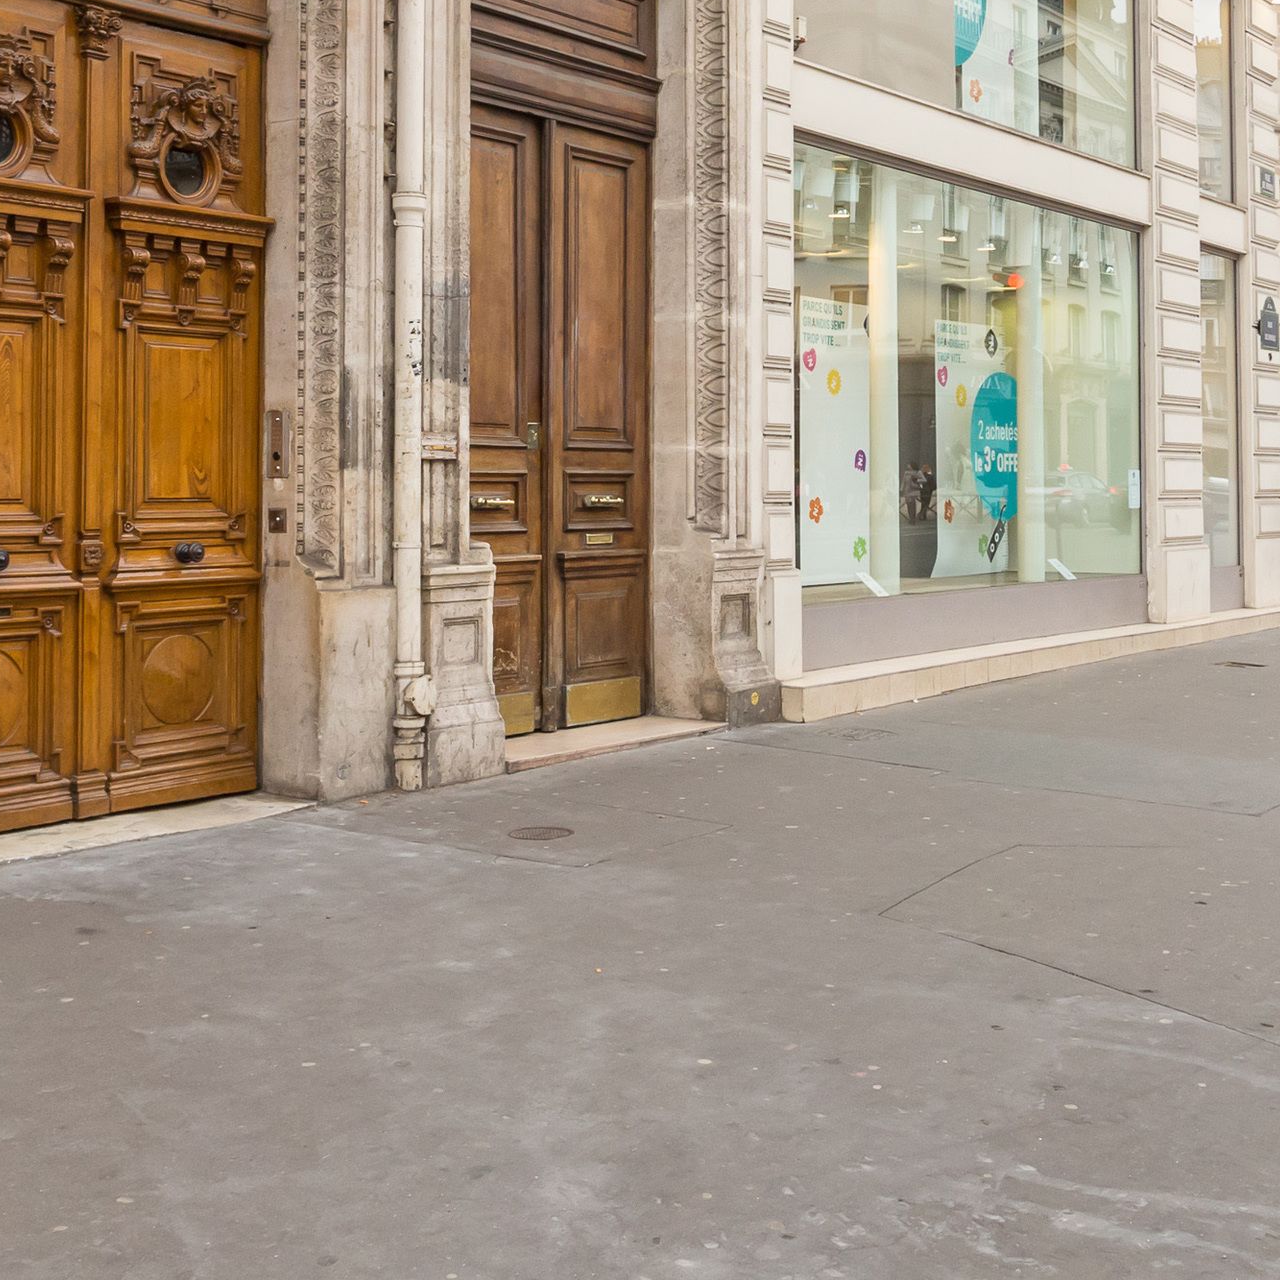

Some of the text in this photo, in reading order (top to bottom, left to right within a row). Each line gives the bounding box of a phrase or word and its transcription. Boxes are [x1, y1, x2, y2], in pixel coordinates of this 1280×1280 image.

[802, 300, 823, 314] PARCE
[802, 316, 845, 330] GRANDISSENT
[802, 331, 820, 344] TROP
[978, 420, 1018, 441] 2 achetés
[974, 452, 983, 471] le
[997, 453, 1018, 473] OFFE
